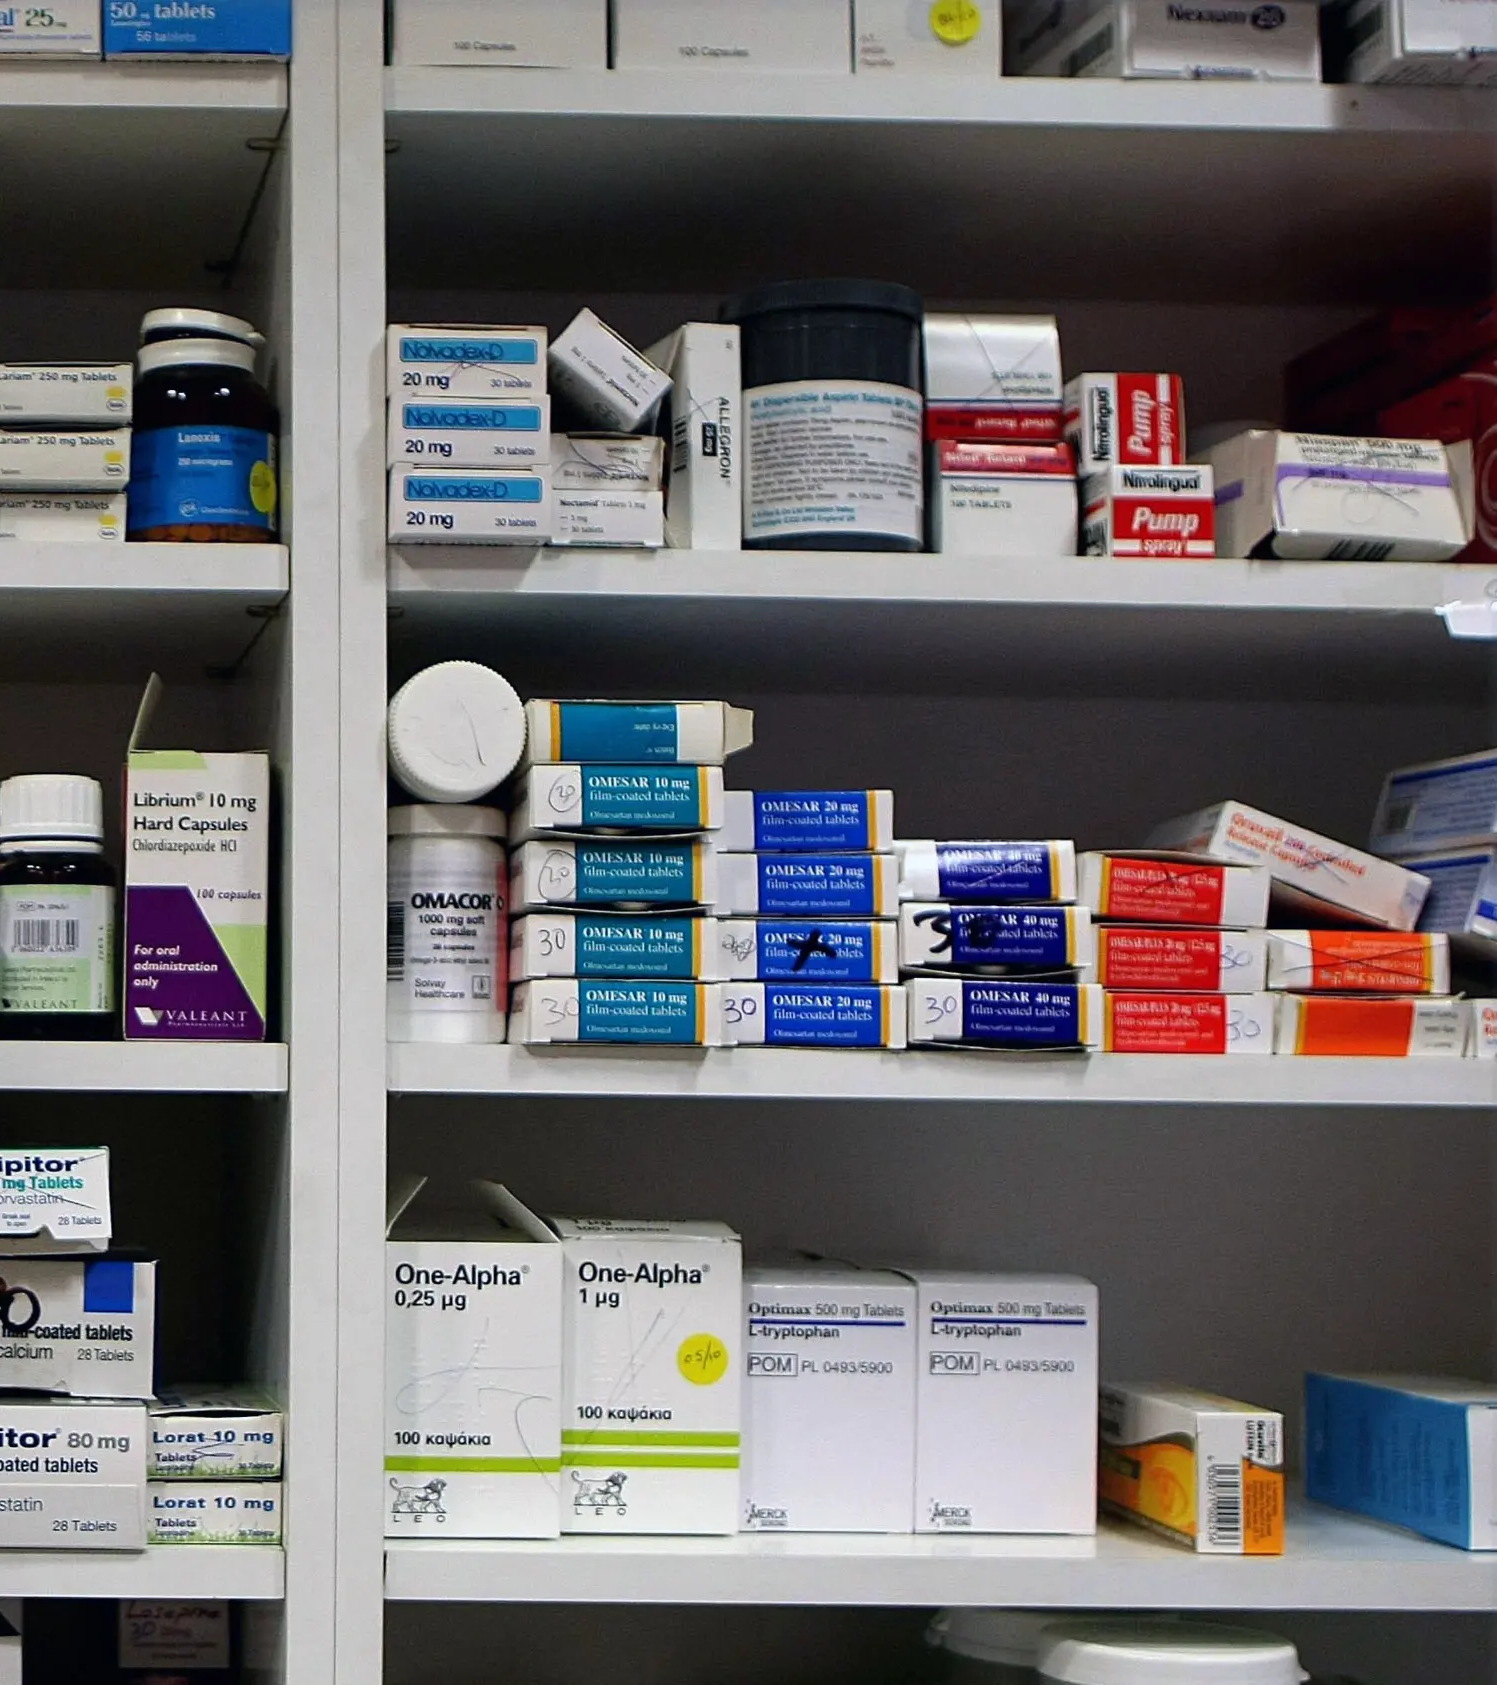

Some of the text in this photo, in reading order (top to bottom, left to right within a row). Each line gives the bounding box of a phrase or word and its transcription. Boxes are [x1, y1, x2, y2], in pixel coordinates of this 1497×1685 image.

[110, 2, 215, 19] 50 tablets
[24, 10, 53, 27] 25
[39, 372, 58, 381] 250
[62, 374, 78, 384] mg
[81, 372, 117, 382] Tablets
[407, 410, 506, 426] Nolvadex-D
[1128, 389, 1156, 455] Pump
[718, 397, 731, 479] ALLEGRON
[406, 441, 452, 456] 20 mg
[494, 446, 535, 455] 30 tablets
[1132, 508, 1199, 535] Pump
[589, 776, 690, 790] OMESAR 10 mg
[590, 789, 689, 802] film-coated tablets
[210, 795, 226, 807] 10
[231, 797, 256, 812] mg
[133, 817, 248, 833] Hard Capsules
[133, 839, 216, 854] Chlordiazepoxide
[196, 889, 261, 901] 100 capsules
[412, 893, 492, 910] OMACOR
[419, 914, 484, 927] 1000 mg soft
[431, 926, 477, 938] capsules
[134, 945, 180, 955] For oral
[539, 929, 566, 956] 30
[134, 961, 217, 972] administration
[134, 977, 158, 989] only
[415, 979, 446, 989] Solvay
[415, 989, 465, 999] Healthcare
[773, 995, 872, 1010] OMESAR 20 mg
[166, 1011, 247, 1021] VALEANT
[724, 998, 756, 1024] 30
[773, 1008, 873, 1021] film-coated tablets
[395, 1291, 434, 1308] 0,25
[580, 1289, 587, 1303] 1
[749, 1303, 904, 1319] Optimax 500 mg Tablets
[85, 1325, 132, 1341] tablets
[749, 1326, 839, 1339] L-tryptophan
[78, 1349, 134, 1362] 28 Tablets
[750, 1357, 893, 1373] POM PL 0493/5900
[577, 1407, 671, 1422] 100 καψάκια
[68, 1434, 92, 1448] 80
[97, 1436, 130, 1452] mg
[394, 1432, 491, 1448] 100 καψάκια
[44, 1457, 98, 1473] tablets
[154, 1497, 274, 1512] Lorat 10 mg
[52, 1521, 117, 1532] 28 Tablets
[155, 1519, 196, 1528] Tablets
